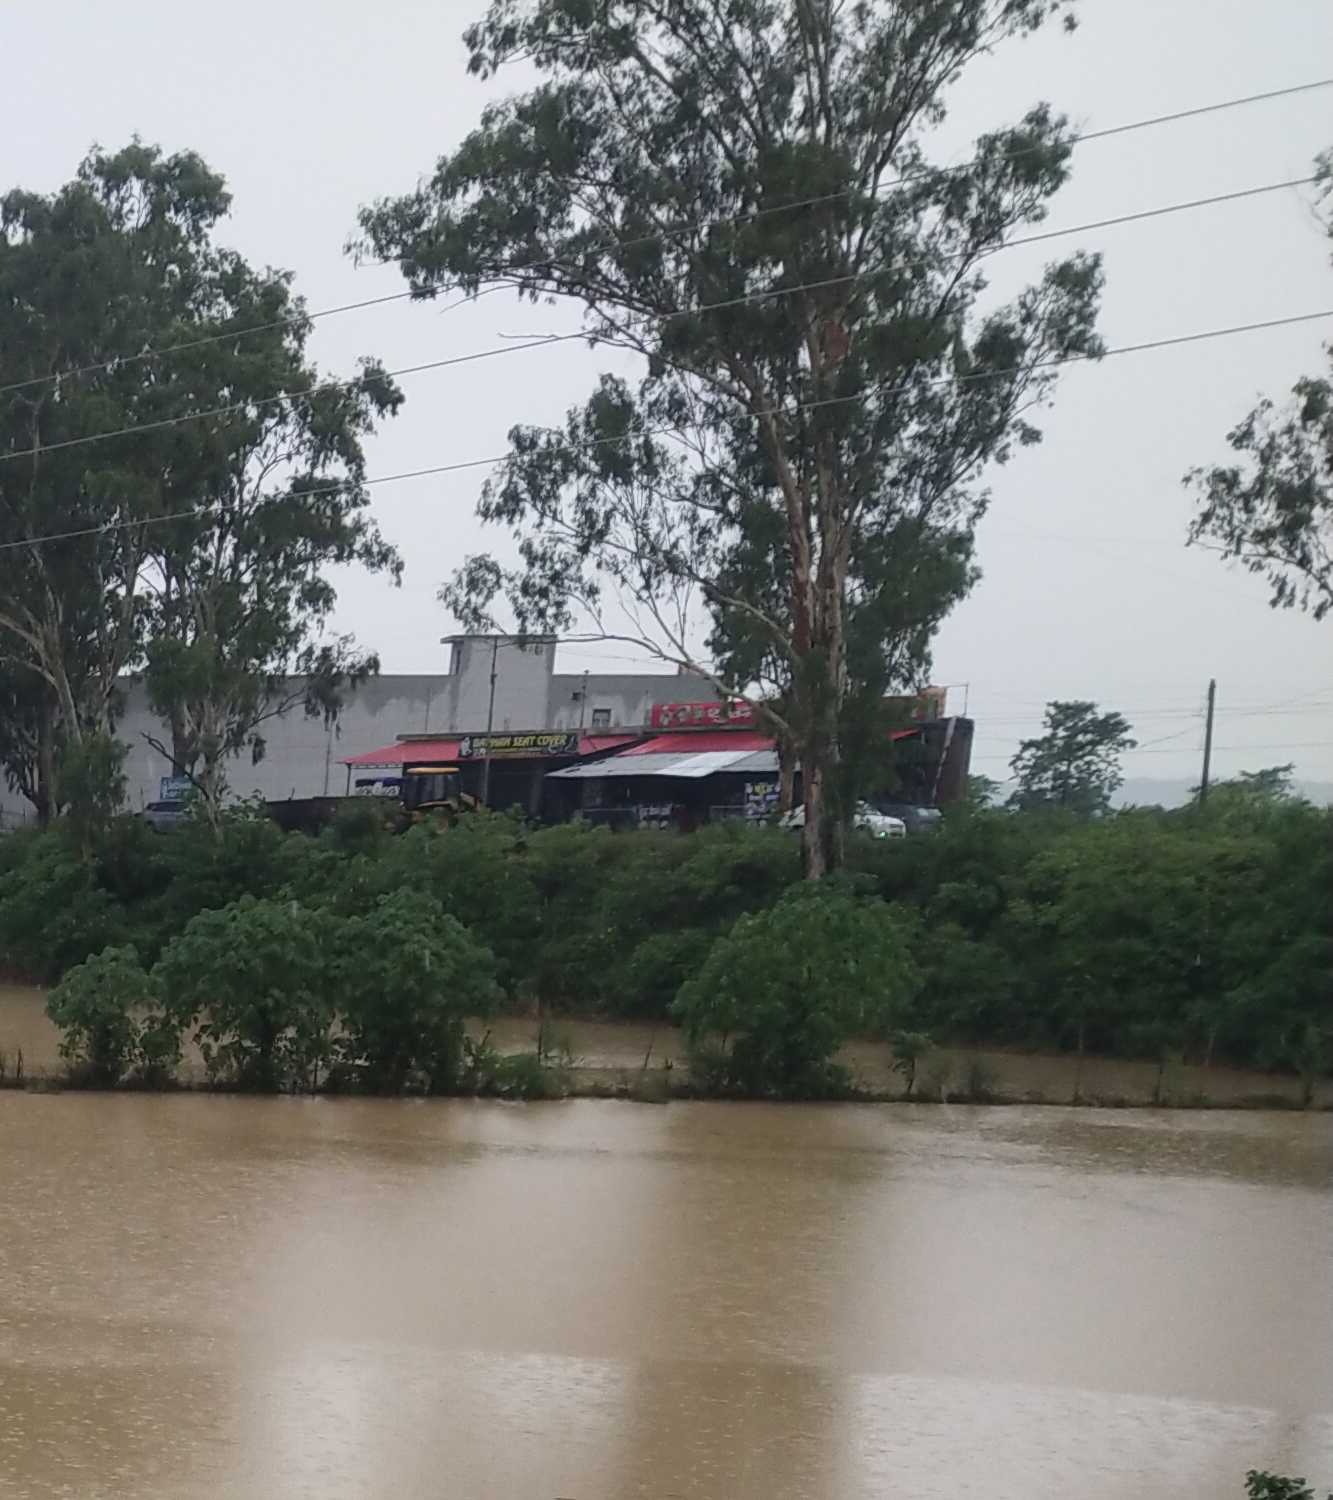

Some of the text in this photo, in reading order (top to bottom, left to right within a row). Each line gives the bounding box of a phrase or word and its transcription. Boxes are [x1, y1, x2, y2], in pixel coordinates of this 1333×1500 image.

[473, 734, 567, 748] BAMAN SEAT COVER
